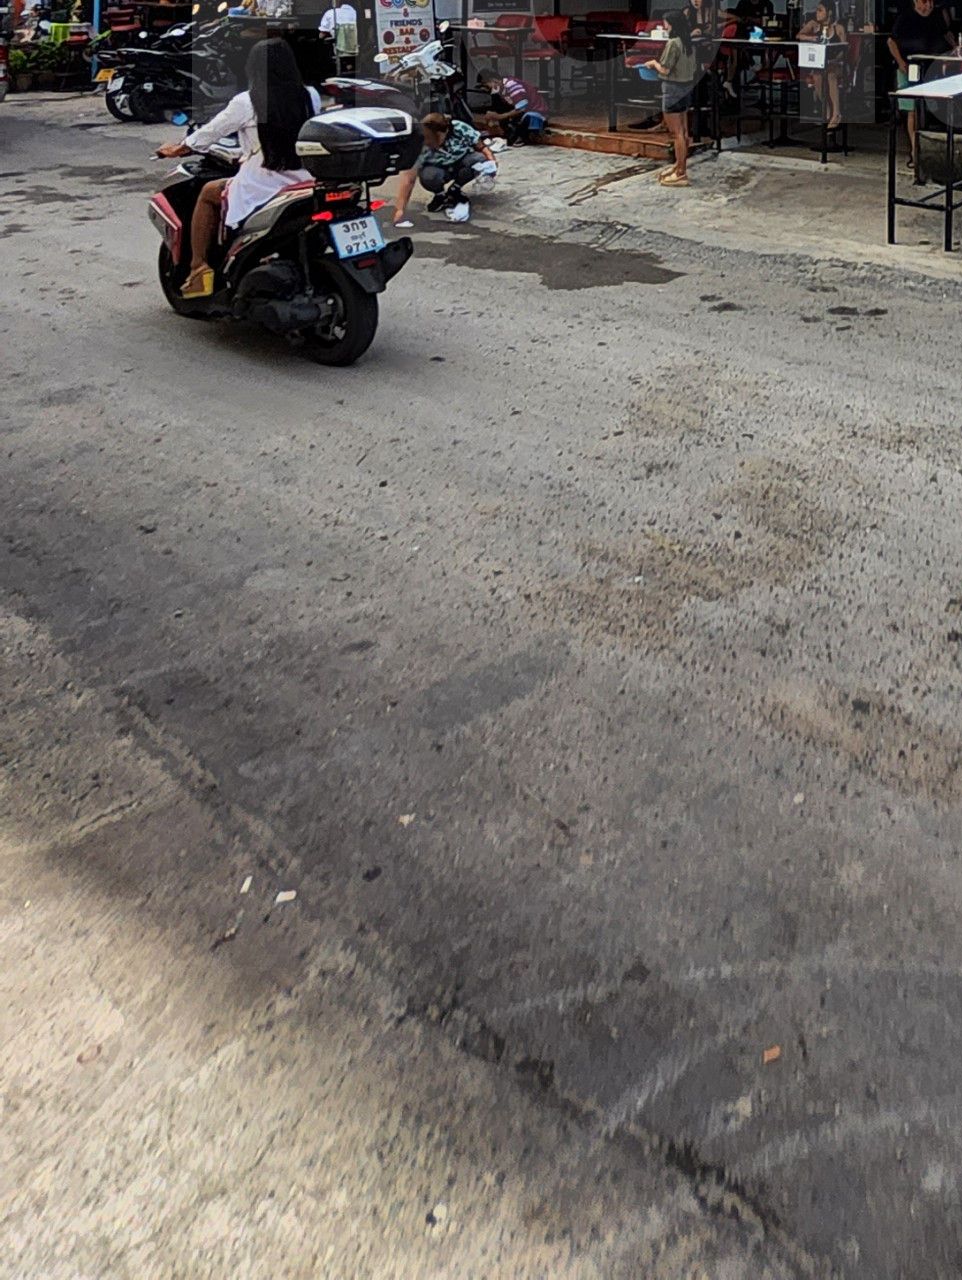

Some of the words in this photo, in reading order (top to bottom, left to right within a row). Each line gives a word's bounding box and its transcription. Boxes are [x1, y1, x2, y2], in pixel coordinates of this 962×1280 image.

[403, 7, 409, 18] &
[390, 18, 423, 28] FRIENDS
[399, 27, 415, 36] BAR
[345, 237, 378, 254] 9713
